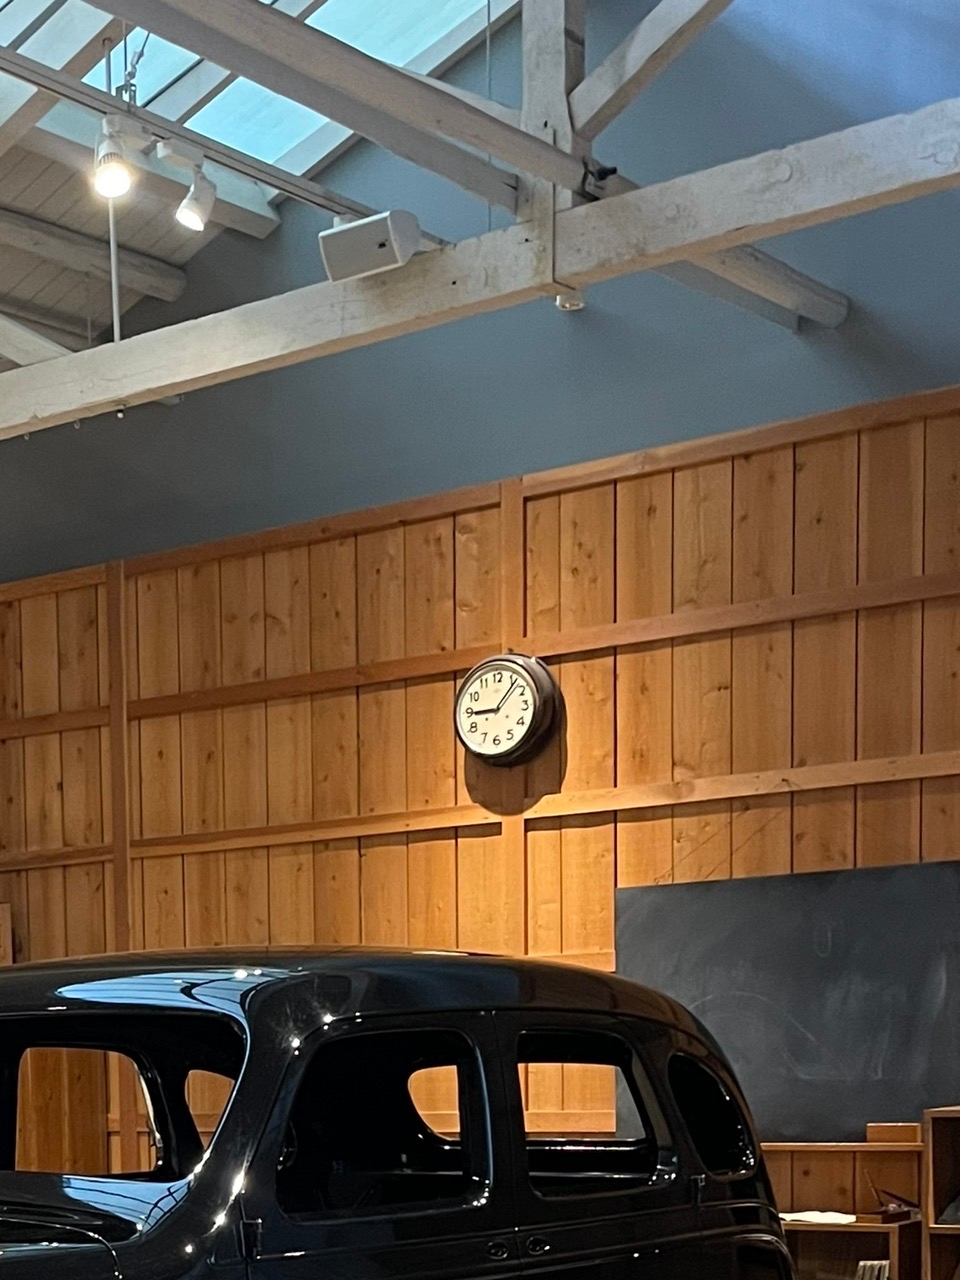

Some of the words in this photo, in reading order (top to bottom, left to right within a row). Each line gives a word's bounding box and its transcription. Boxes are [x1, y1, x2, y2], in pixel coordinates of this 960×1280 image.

[480, 678, 488, 688] 11
[493, 672, 503, 683] 12
[518, 685, 526, 696] 2
[470, 691, 480, 702] 10
[521, 700, 529, 711] 3
[465, 707, 474, 718] 9
[516, 716, 525, 726] 4
[470, 722, 478, 733] 8
[481, 732, 488, 744] 7
[492, 734, 501, 746] 6
[506, 729, 514, 740] 5
